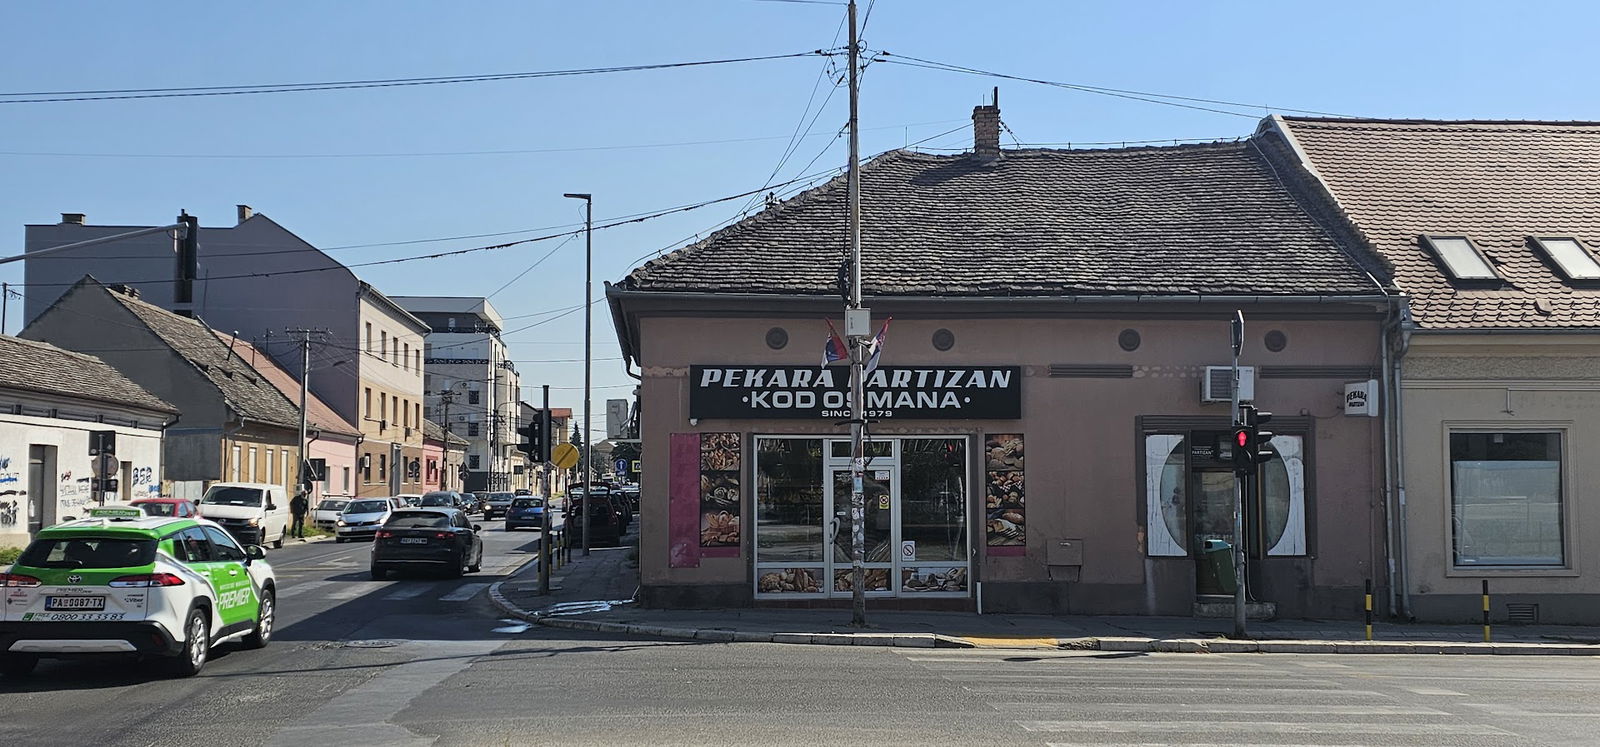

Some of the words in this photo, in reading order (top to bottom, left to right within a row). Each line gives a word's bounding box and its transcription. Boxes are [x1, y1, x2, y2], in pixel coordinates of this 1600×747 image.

[700, 369, 834, 388] PEKARA
[848, 369, 1011, 388] ARTIZAN
[751, 391, 816, 408] KOD
[218, 587, 251, 610] PREMIER
